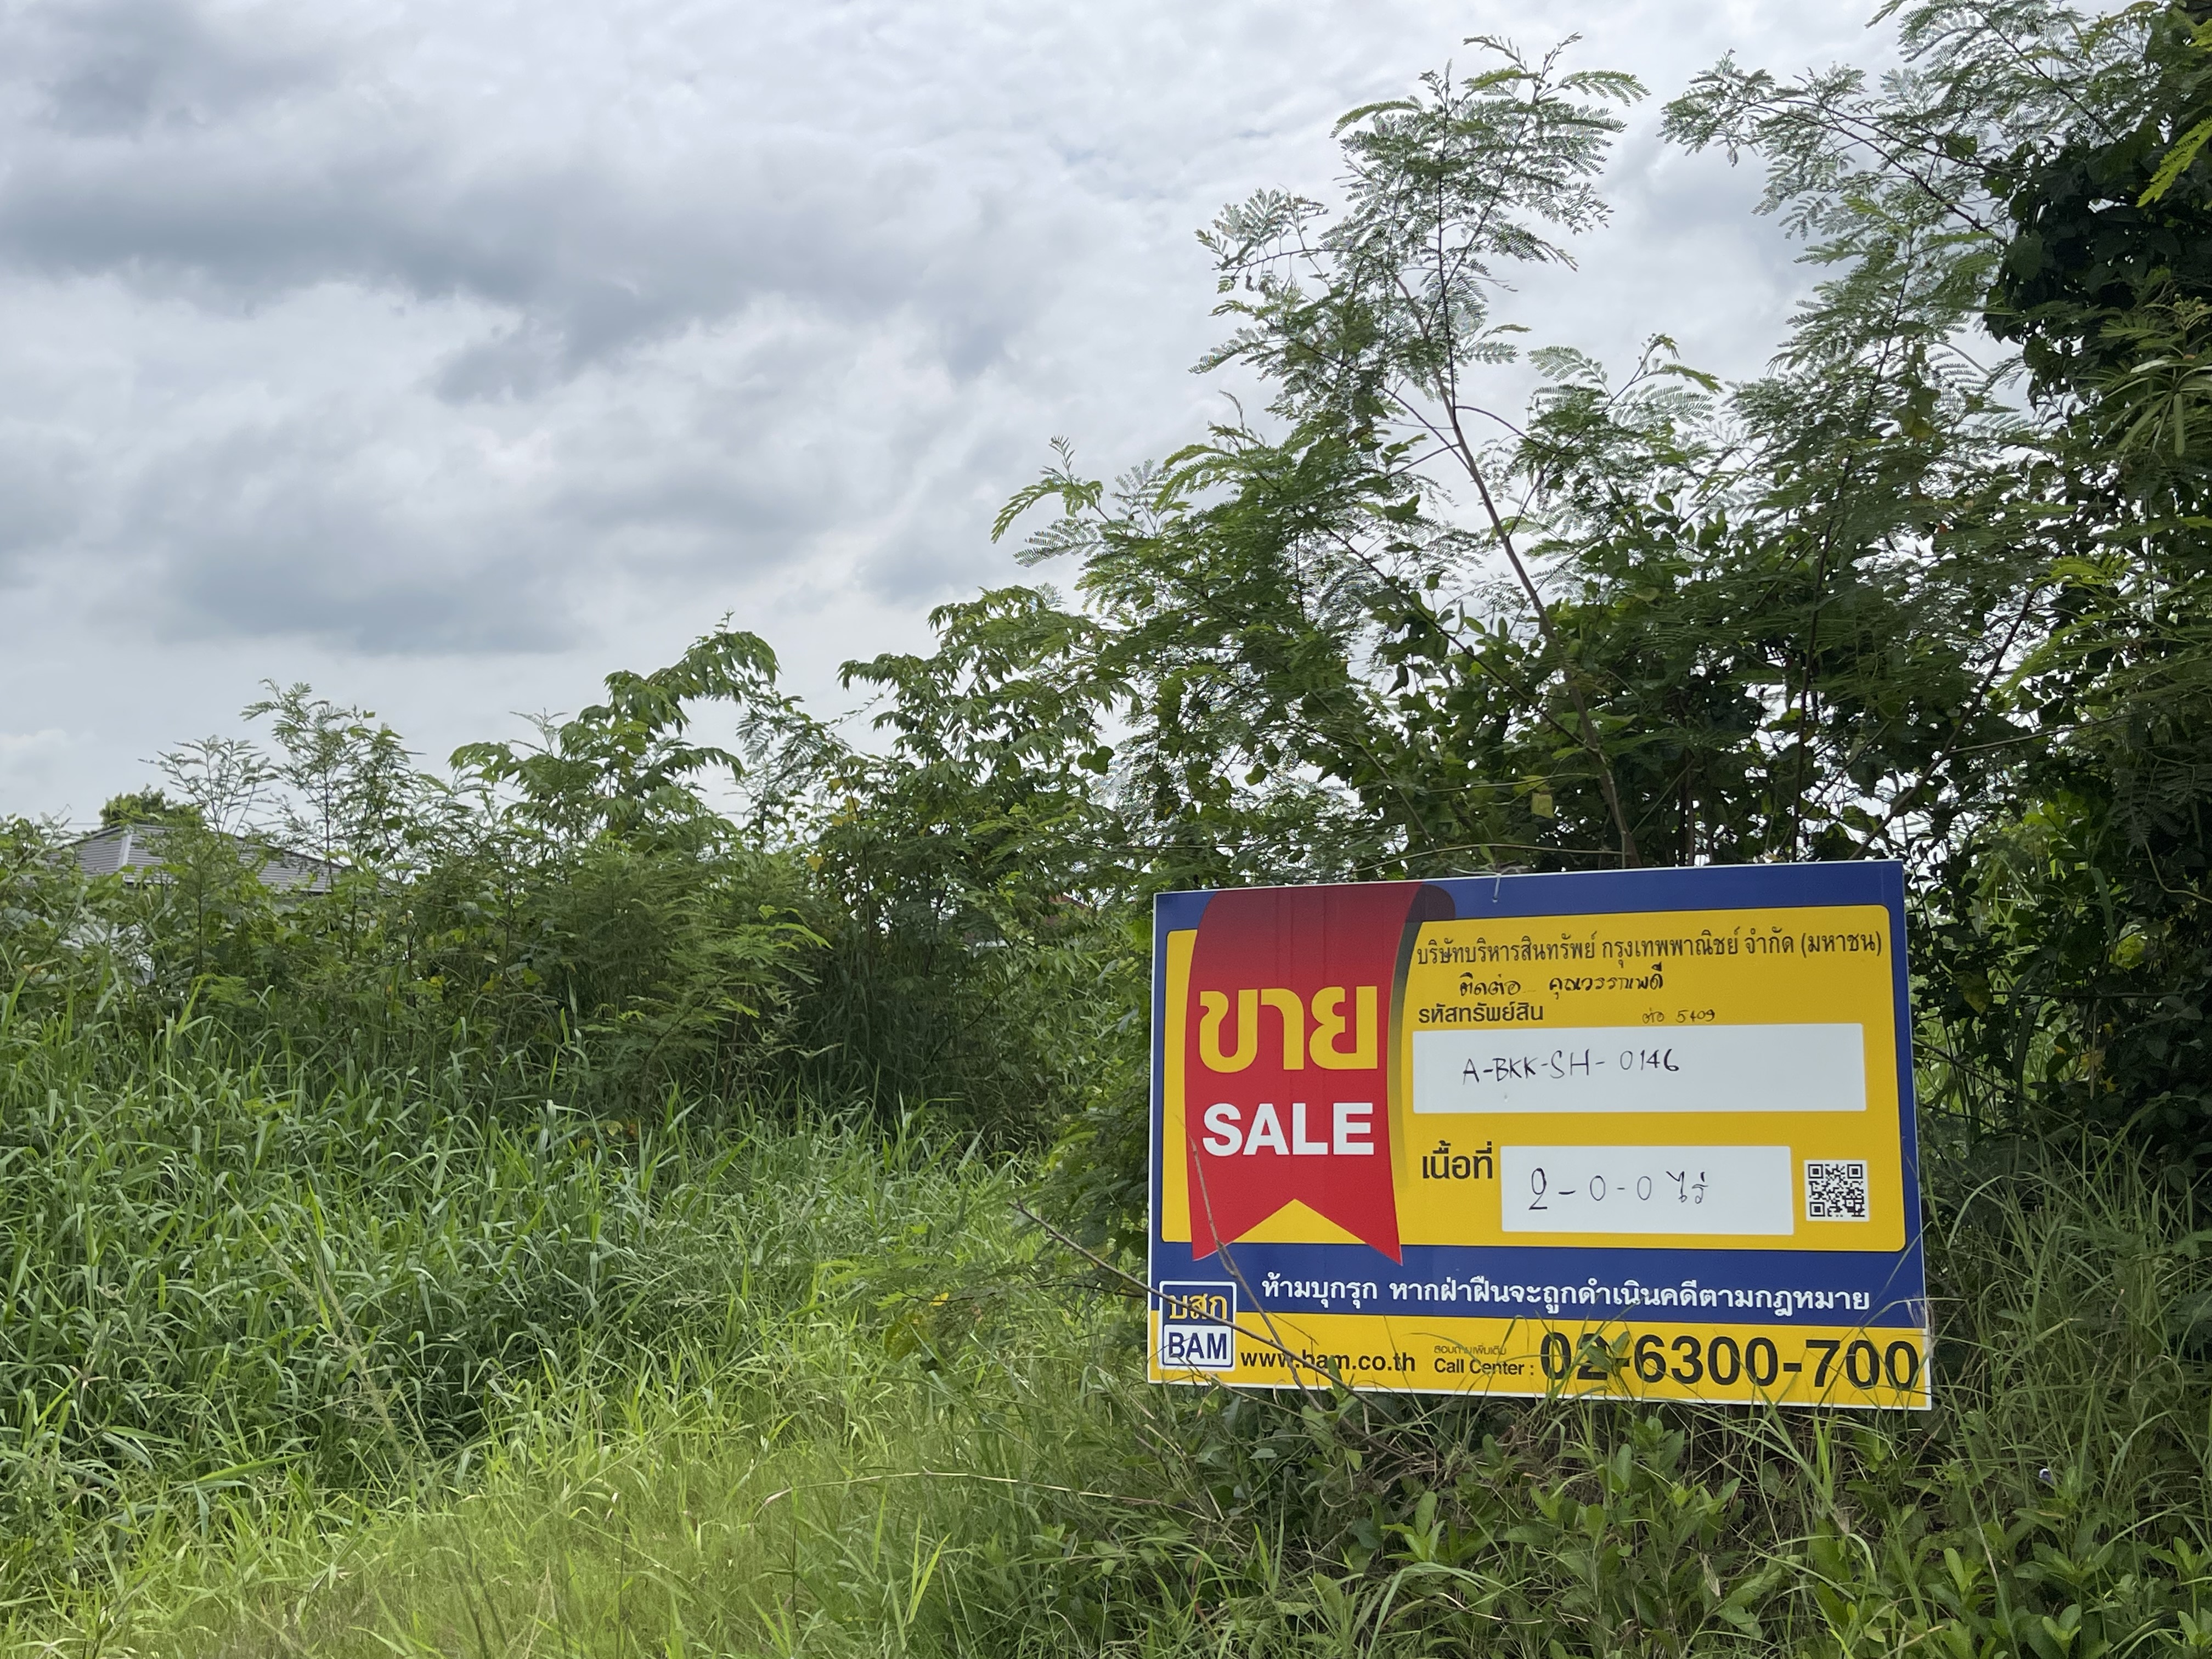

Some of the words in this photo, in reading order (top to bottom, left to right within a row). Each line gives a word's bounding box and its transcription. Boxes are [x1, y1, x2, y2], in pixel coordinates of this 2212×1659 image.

[1417, 930, 1598, 964] บริษัทบริหารสินทรัพย์
[1602, 926, 1740, 968] กรุงเทพพาณิชย์
[1744, 926, 1795, 955] จำกัด
[1801, 931, 1882, 958] (มหาชน)
[1459, 972, 1521, 997] ติดต่อ
[1199, 986, 1378, 1073] ขาย
[1418, 1001, 1544, 1024] รหัสทรัพย์สิน
[1203, 1103, 1374, 1156] SALE
[1422, 1140, 1493, 1180] เนื้อที่
[1169, 1293, 1228, 1320] บสก
[1261, 1272, 1378, 1310] ห้ามบุกรุก
[1389, 1276, 1870, 1317] หากฝ่าฝืนจะถูกดำเนินคดีตามกฎหมาย
[1169, 1332, 1227, 1360] BAM
[1434, 1358, 1464, 1374] Call
